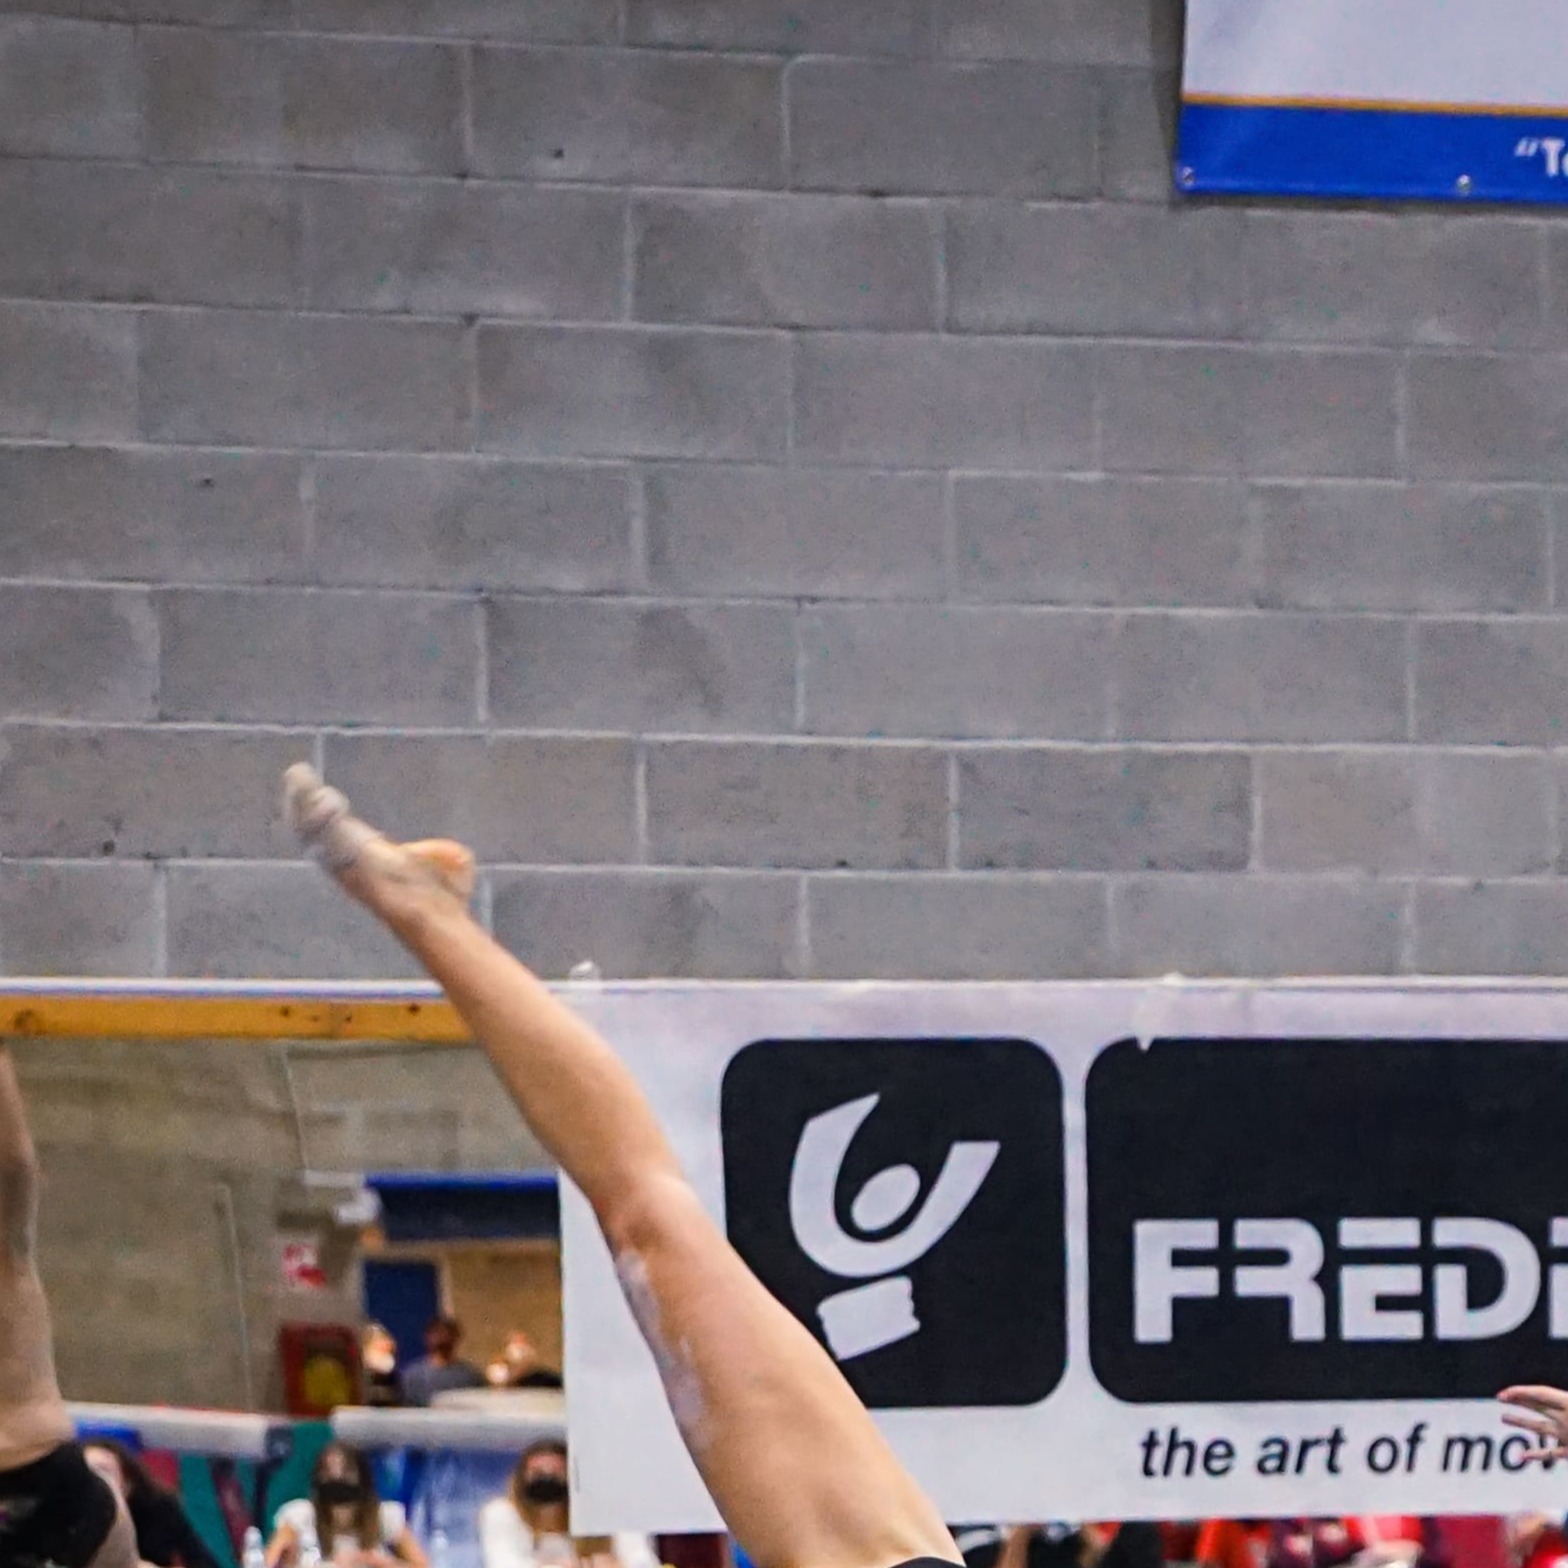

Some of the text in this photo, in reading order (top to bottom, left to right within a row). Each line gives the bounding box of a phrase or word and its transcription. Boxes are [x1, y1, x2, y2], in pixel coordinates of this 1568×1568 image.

[1140, 1426, 1236, 1478] the
[1256, 1425, 1346, 1475] art
[1366, 1421, 1428, 1474] of
